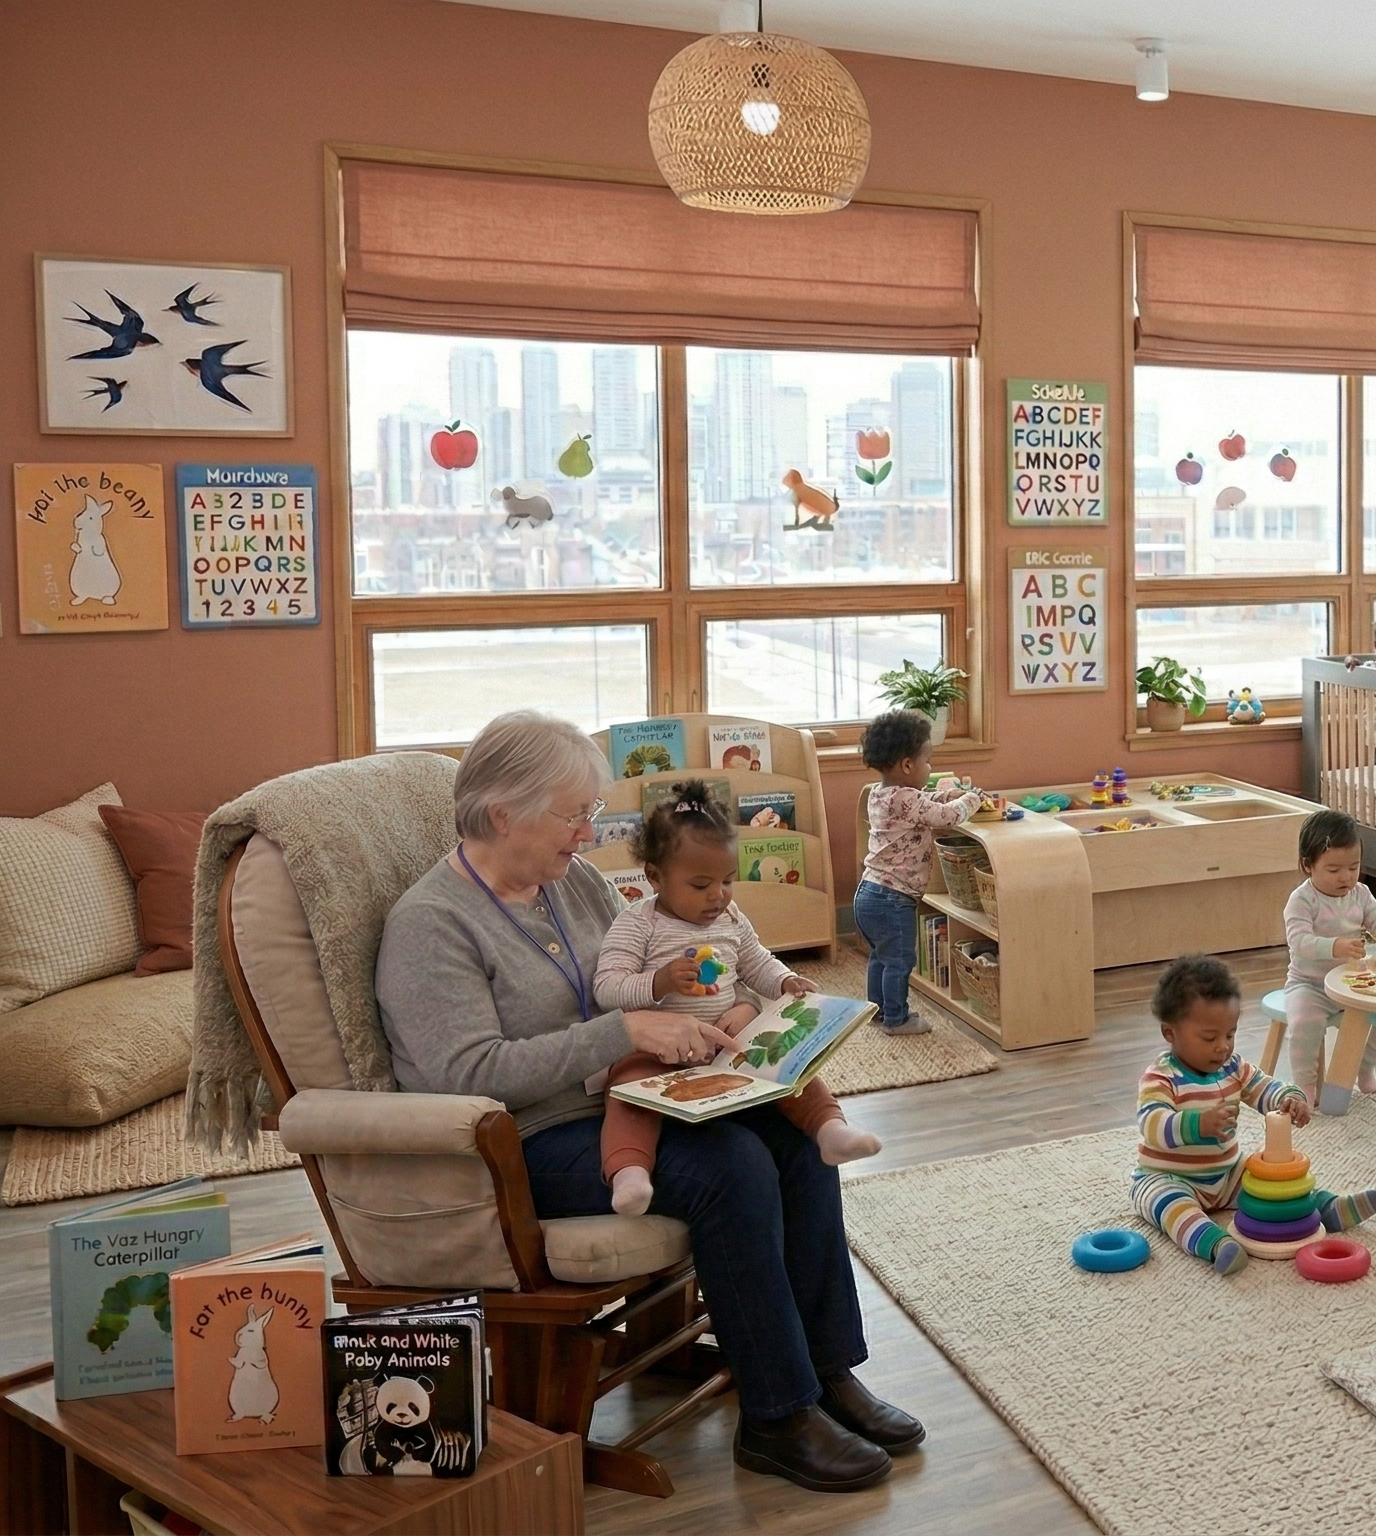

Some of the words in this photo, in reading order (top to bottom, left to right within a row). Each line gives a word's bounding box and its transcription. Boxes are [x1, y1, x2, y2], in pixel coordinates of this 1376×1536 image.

[1021, 574, 1043, 599] A
[1051, 574, 1068, 599] B
[1077, 573, 1097, 598] C
[1026, 605, 1032, 628] I
[1036, 605, 1057, 627] M
[1060, 604, 1076, 627] P
[1078, 603, 1097, 627] Q
[1037, 632, 1054, 656] S
[1043, 663, 1060, 684] X
[1061, 661, 1079, 683] Y
[1081, 661, 1097, 682] Z
[71, 1237, 102, 1252] The
[144, 1228, 205, 1245] Hungry
[216, 1286, 253, 1307] the
[380, 1333, 410, 1349] and
[413, 1333, 461, 1349] White
